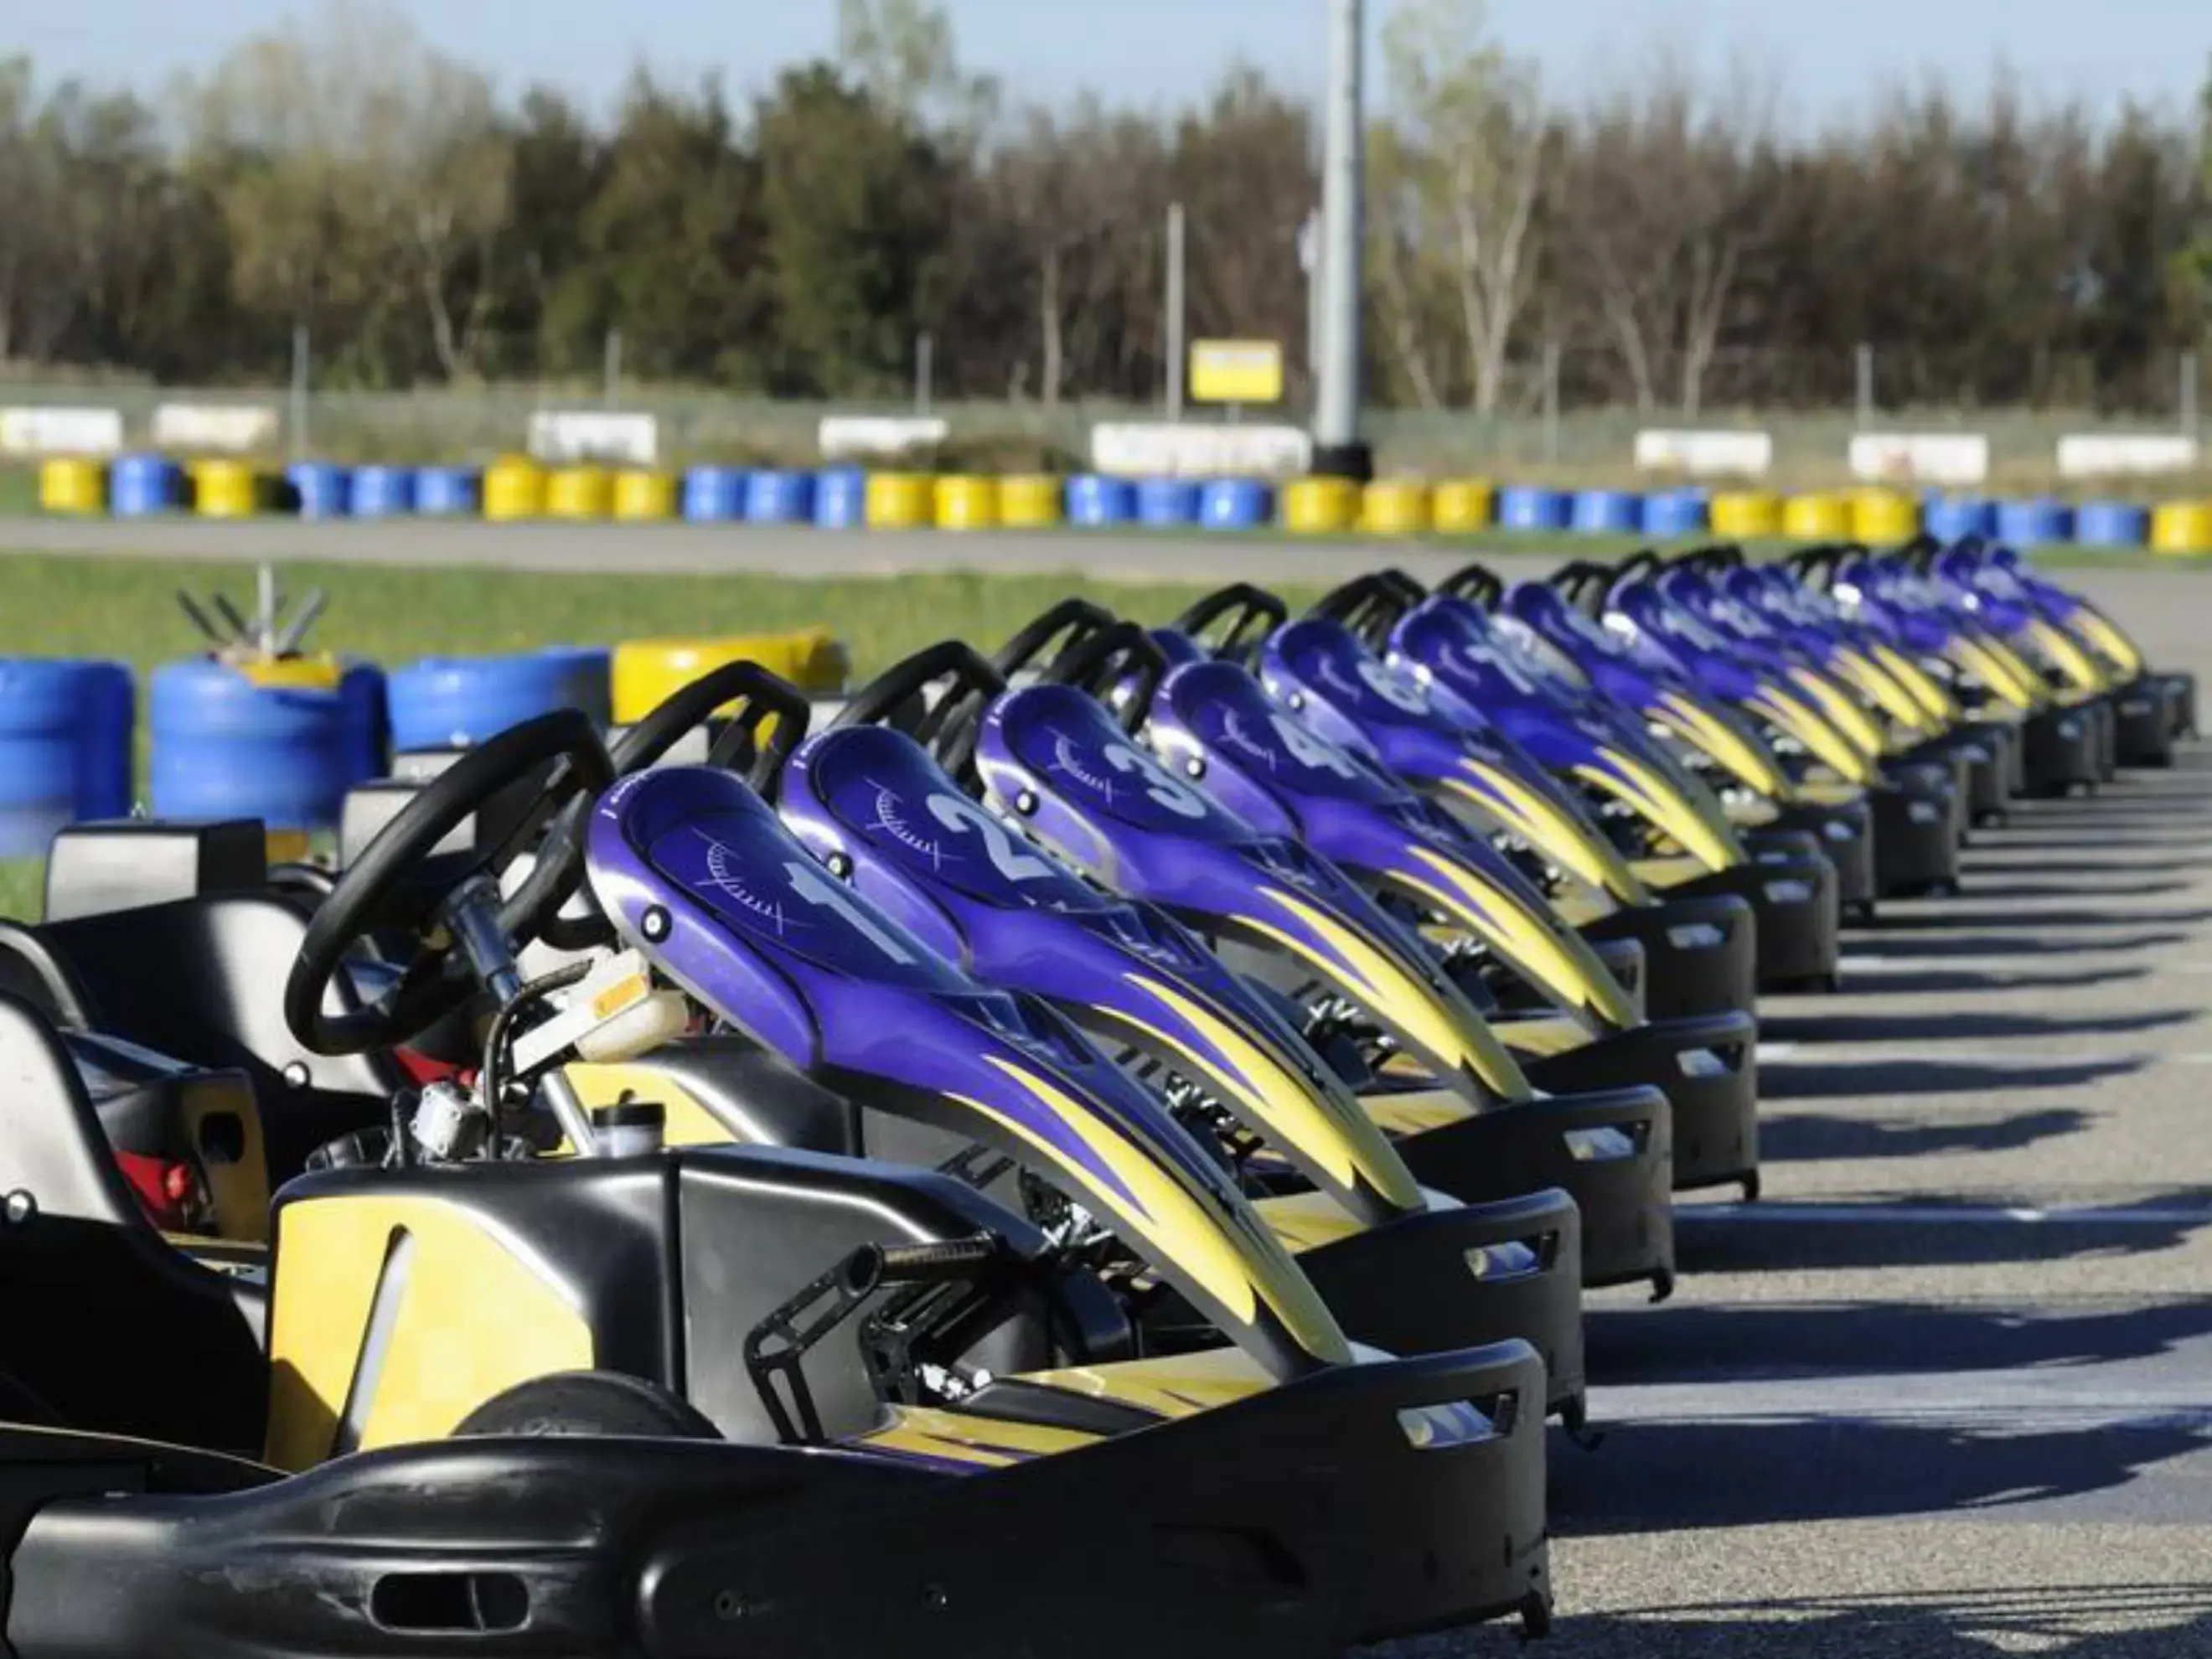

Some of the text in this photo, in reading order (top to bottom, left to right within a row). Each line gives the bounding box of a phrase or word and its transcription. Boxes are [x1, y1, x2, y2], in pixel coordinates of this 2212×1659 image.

[1103, 742, 1207, 819] 3
[1268, 713, 1357, 779] 4
[926, 794, 1057, 881] 2
[783, 862, 918, 965] 1
